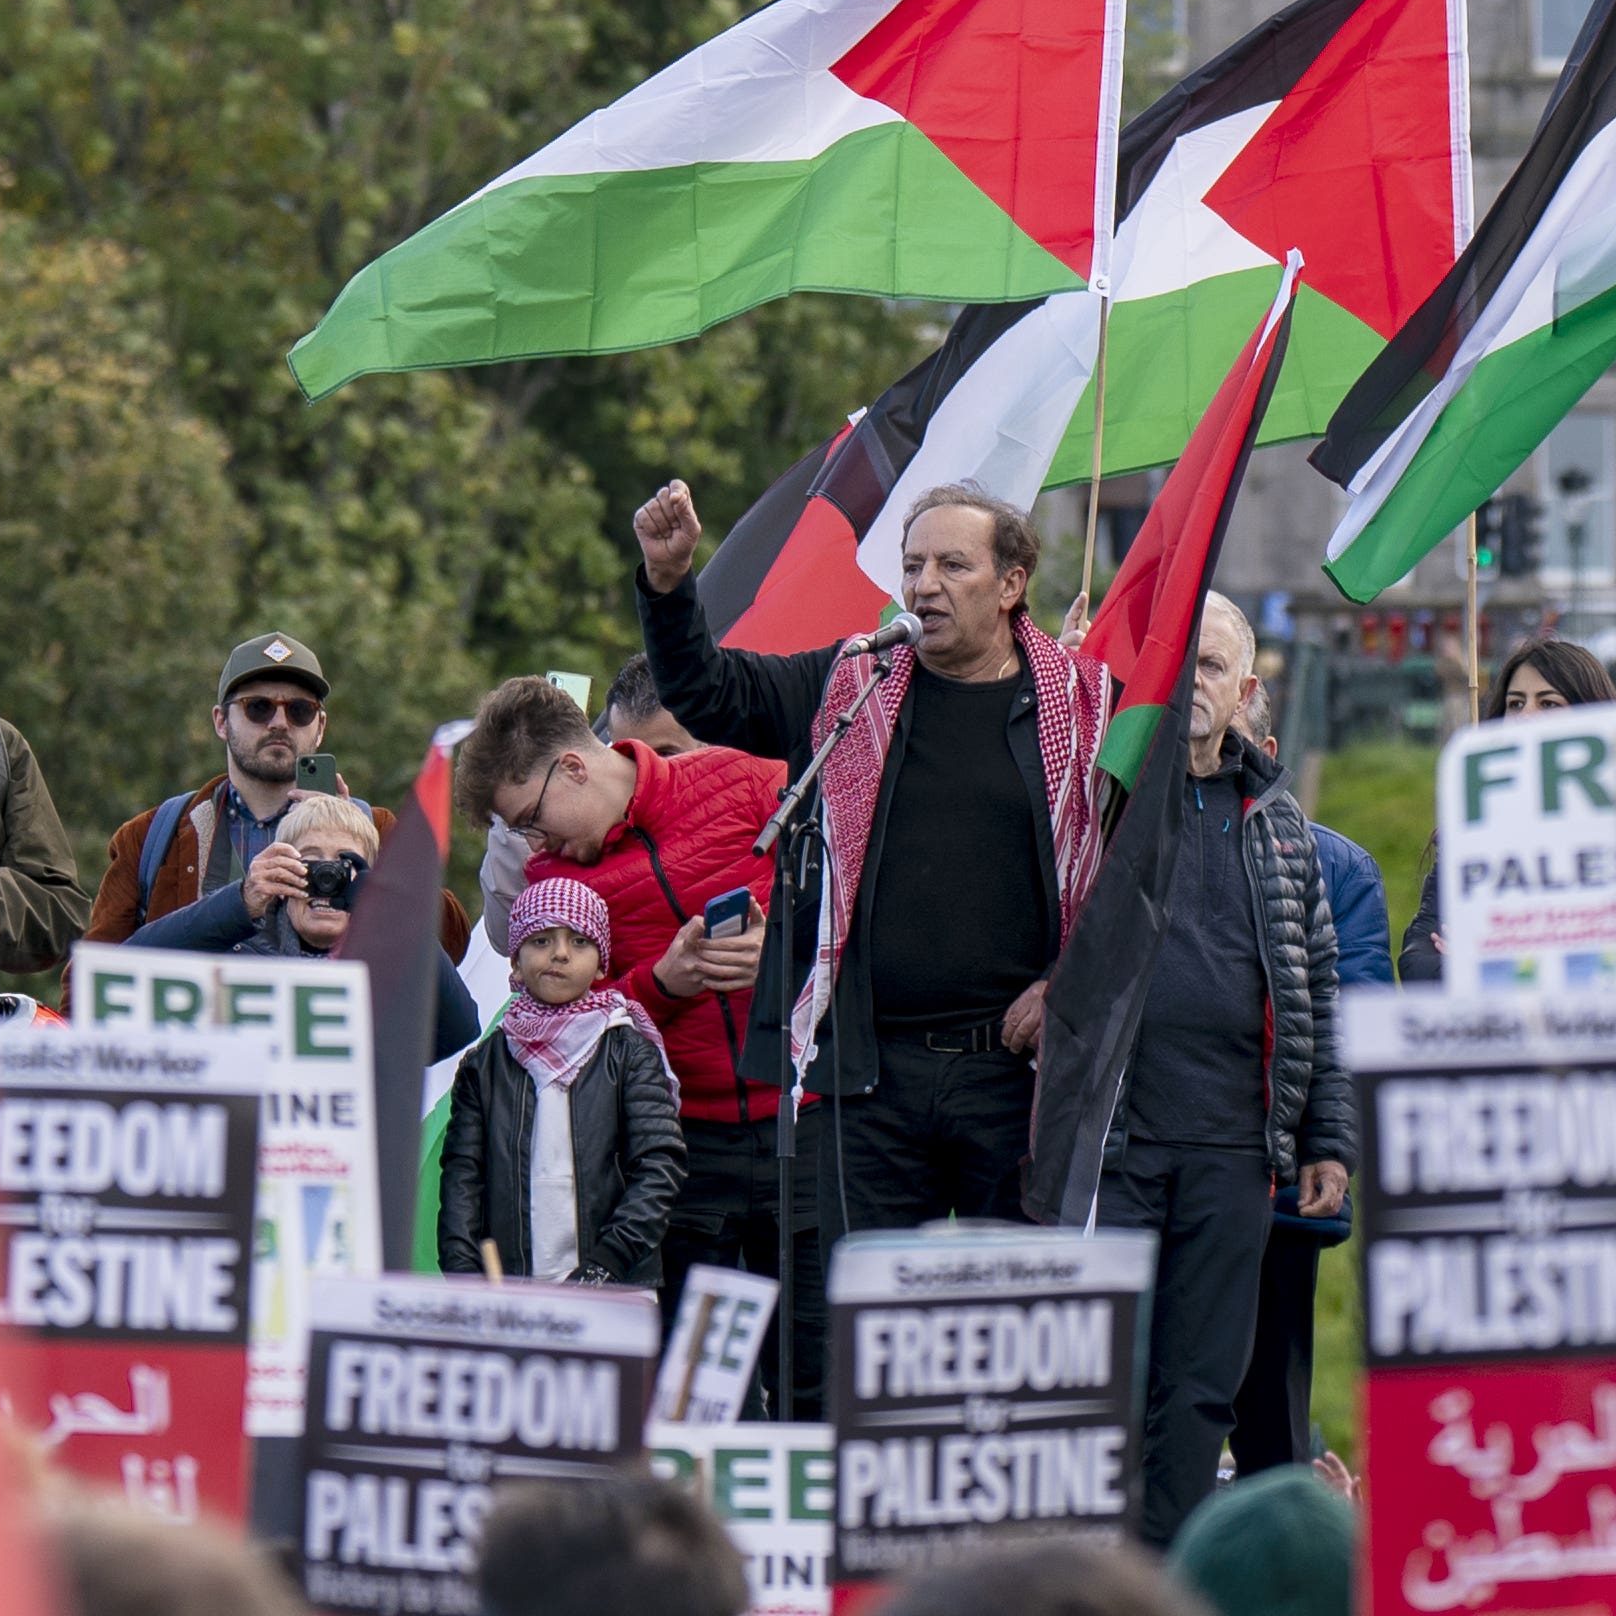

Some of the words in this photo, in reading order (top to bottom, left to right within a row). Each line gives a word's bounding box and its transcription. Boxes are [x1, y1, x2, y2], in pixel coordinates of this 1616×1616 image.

[698, 1292, 760, 1371] EE
[854, 1297, 1113, 1401] FREEDOM
[324, 1337, 621, 1453] FREEDOM
[302, 1469, 494, 1575] PALES
[642, 1446, 833, 1520] REE
[839, 1425, 1127, 1531] PALESTINE
